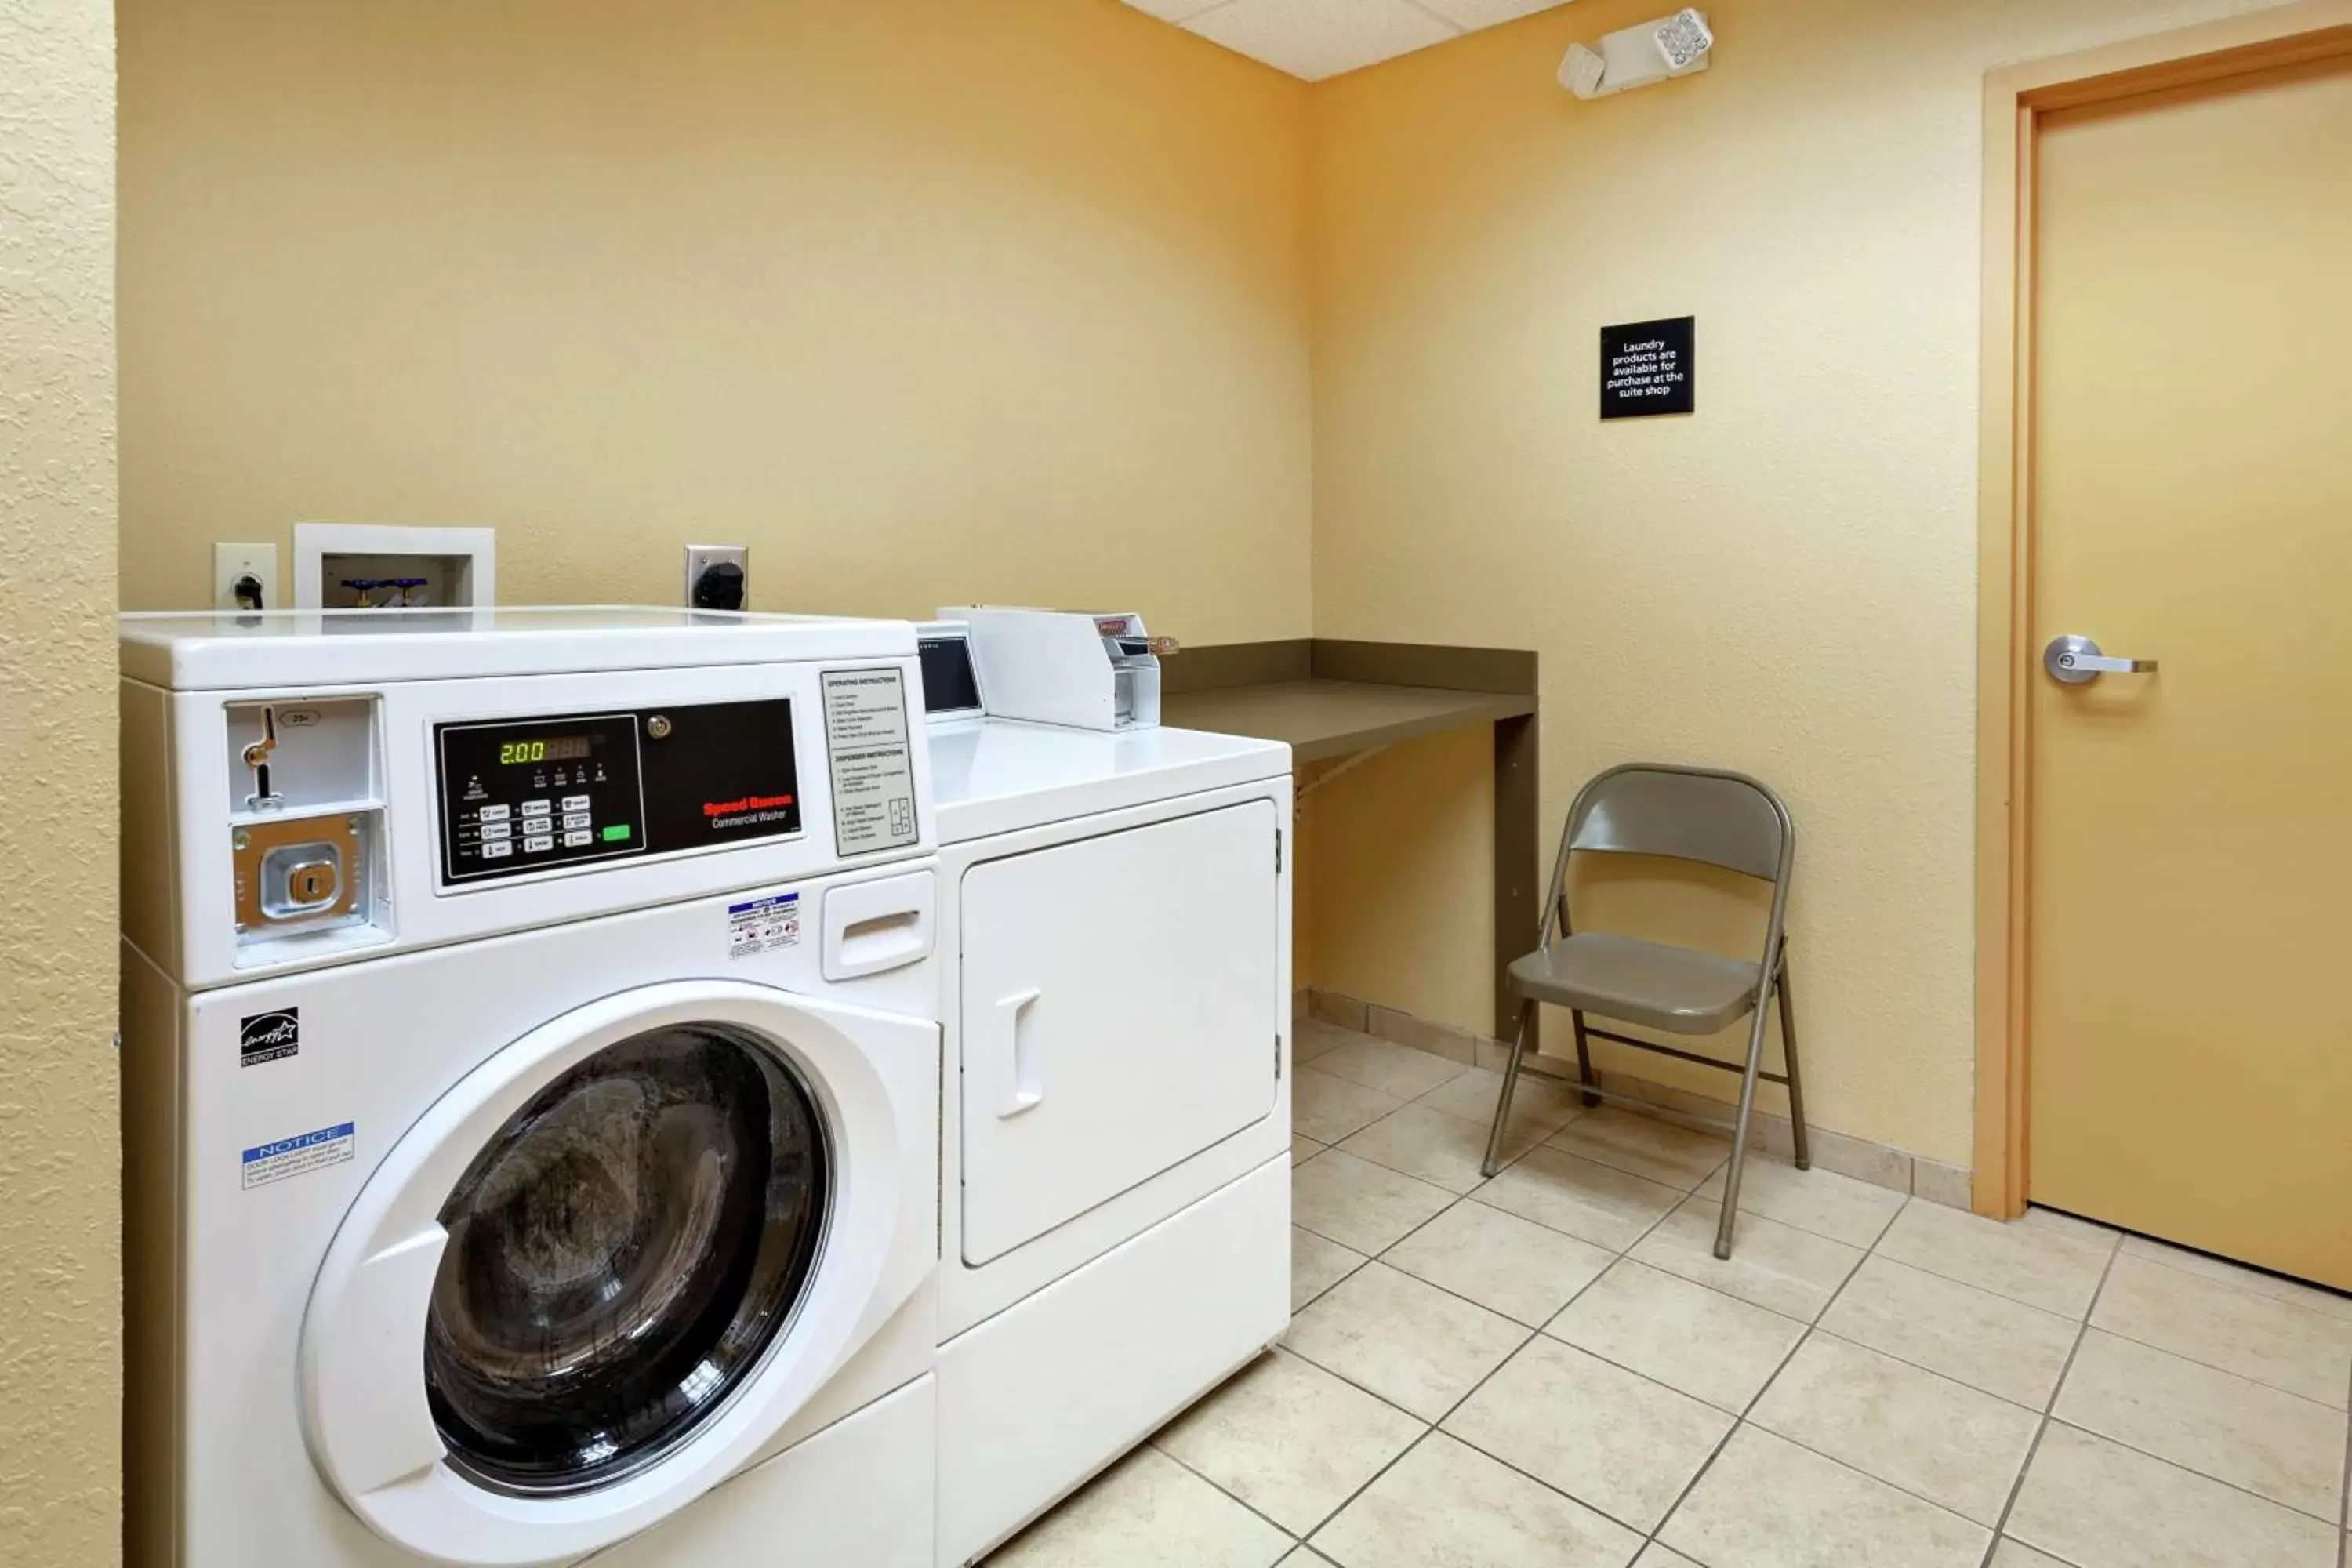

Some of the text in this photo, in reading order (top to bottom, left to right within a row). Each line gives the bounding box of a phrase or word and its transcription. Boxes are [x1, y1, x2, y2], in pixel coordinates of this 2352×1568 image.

[1624, 339, 1665, 352] Laundry
[1613, 350, 1676, 367] products are
[1613, 361, 1676, 376] available for
[1607, 372, 1684, 389] purchase at the
[1619, 385, 1671, 398] suite shop
[500, 742, 543, 764] 2.00
[703, 795, 792, 817] Speed Queen
[712, 810, 786, 829] Commercial Washer
[242, 1046, 298, 1065] ENERGY STAR
[259, 1128, 339, 1157] NOTICE
